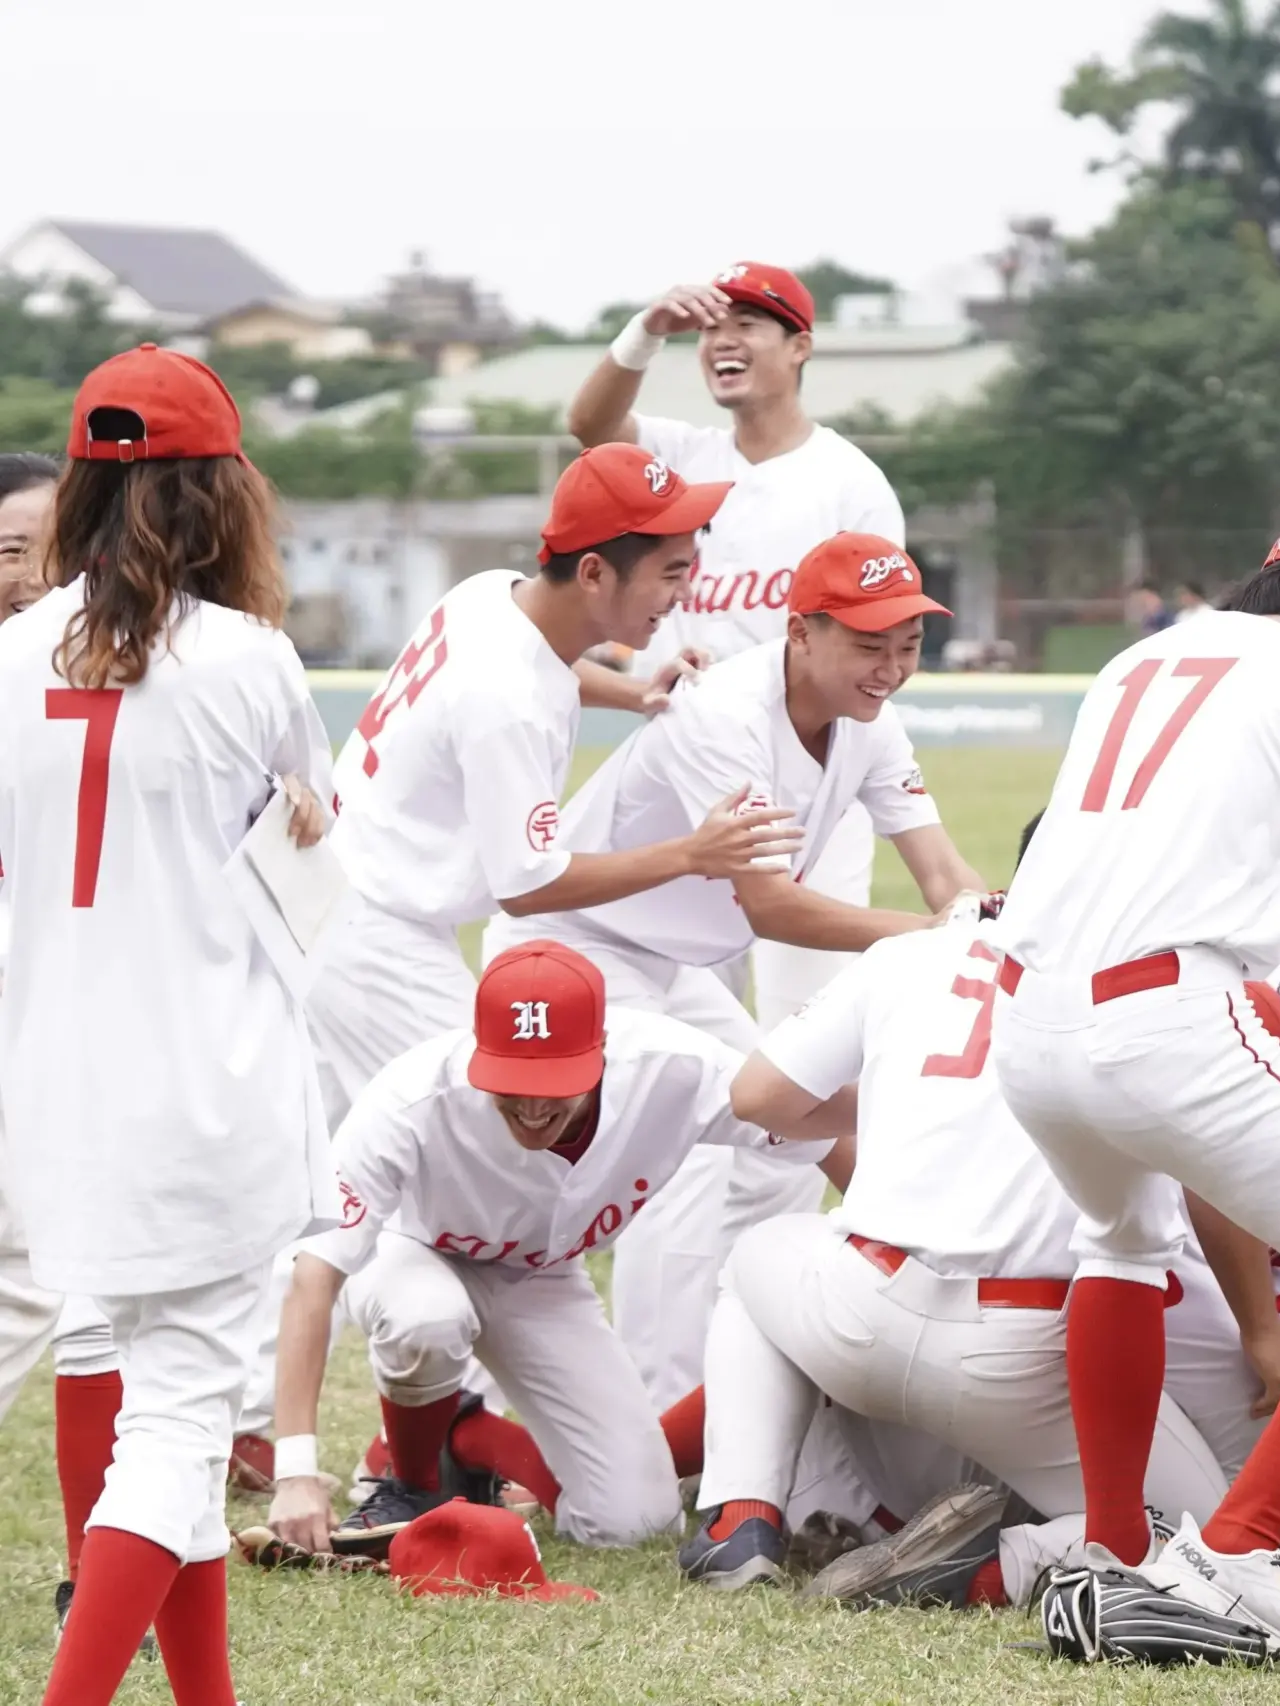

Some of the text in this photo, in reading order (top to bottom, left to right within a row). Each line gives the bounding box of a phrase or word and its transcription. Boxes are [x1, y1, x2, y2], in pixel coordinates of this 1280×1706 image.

[682, 548, 793, 614] ano
[1079, 657, 1241, 813] 17
[45, 688, 125, 908] 7
[509, 999, 552, 1040] H
[1174, 1541, 1218, 1581] HOKA
